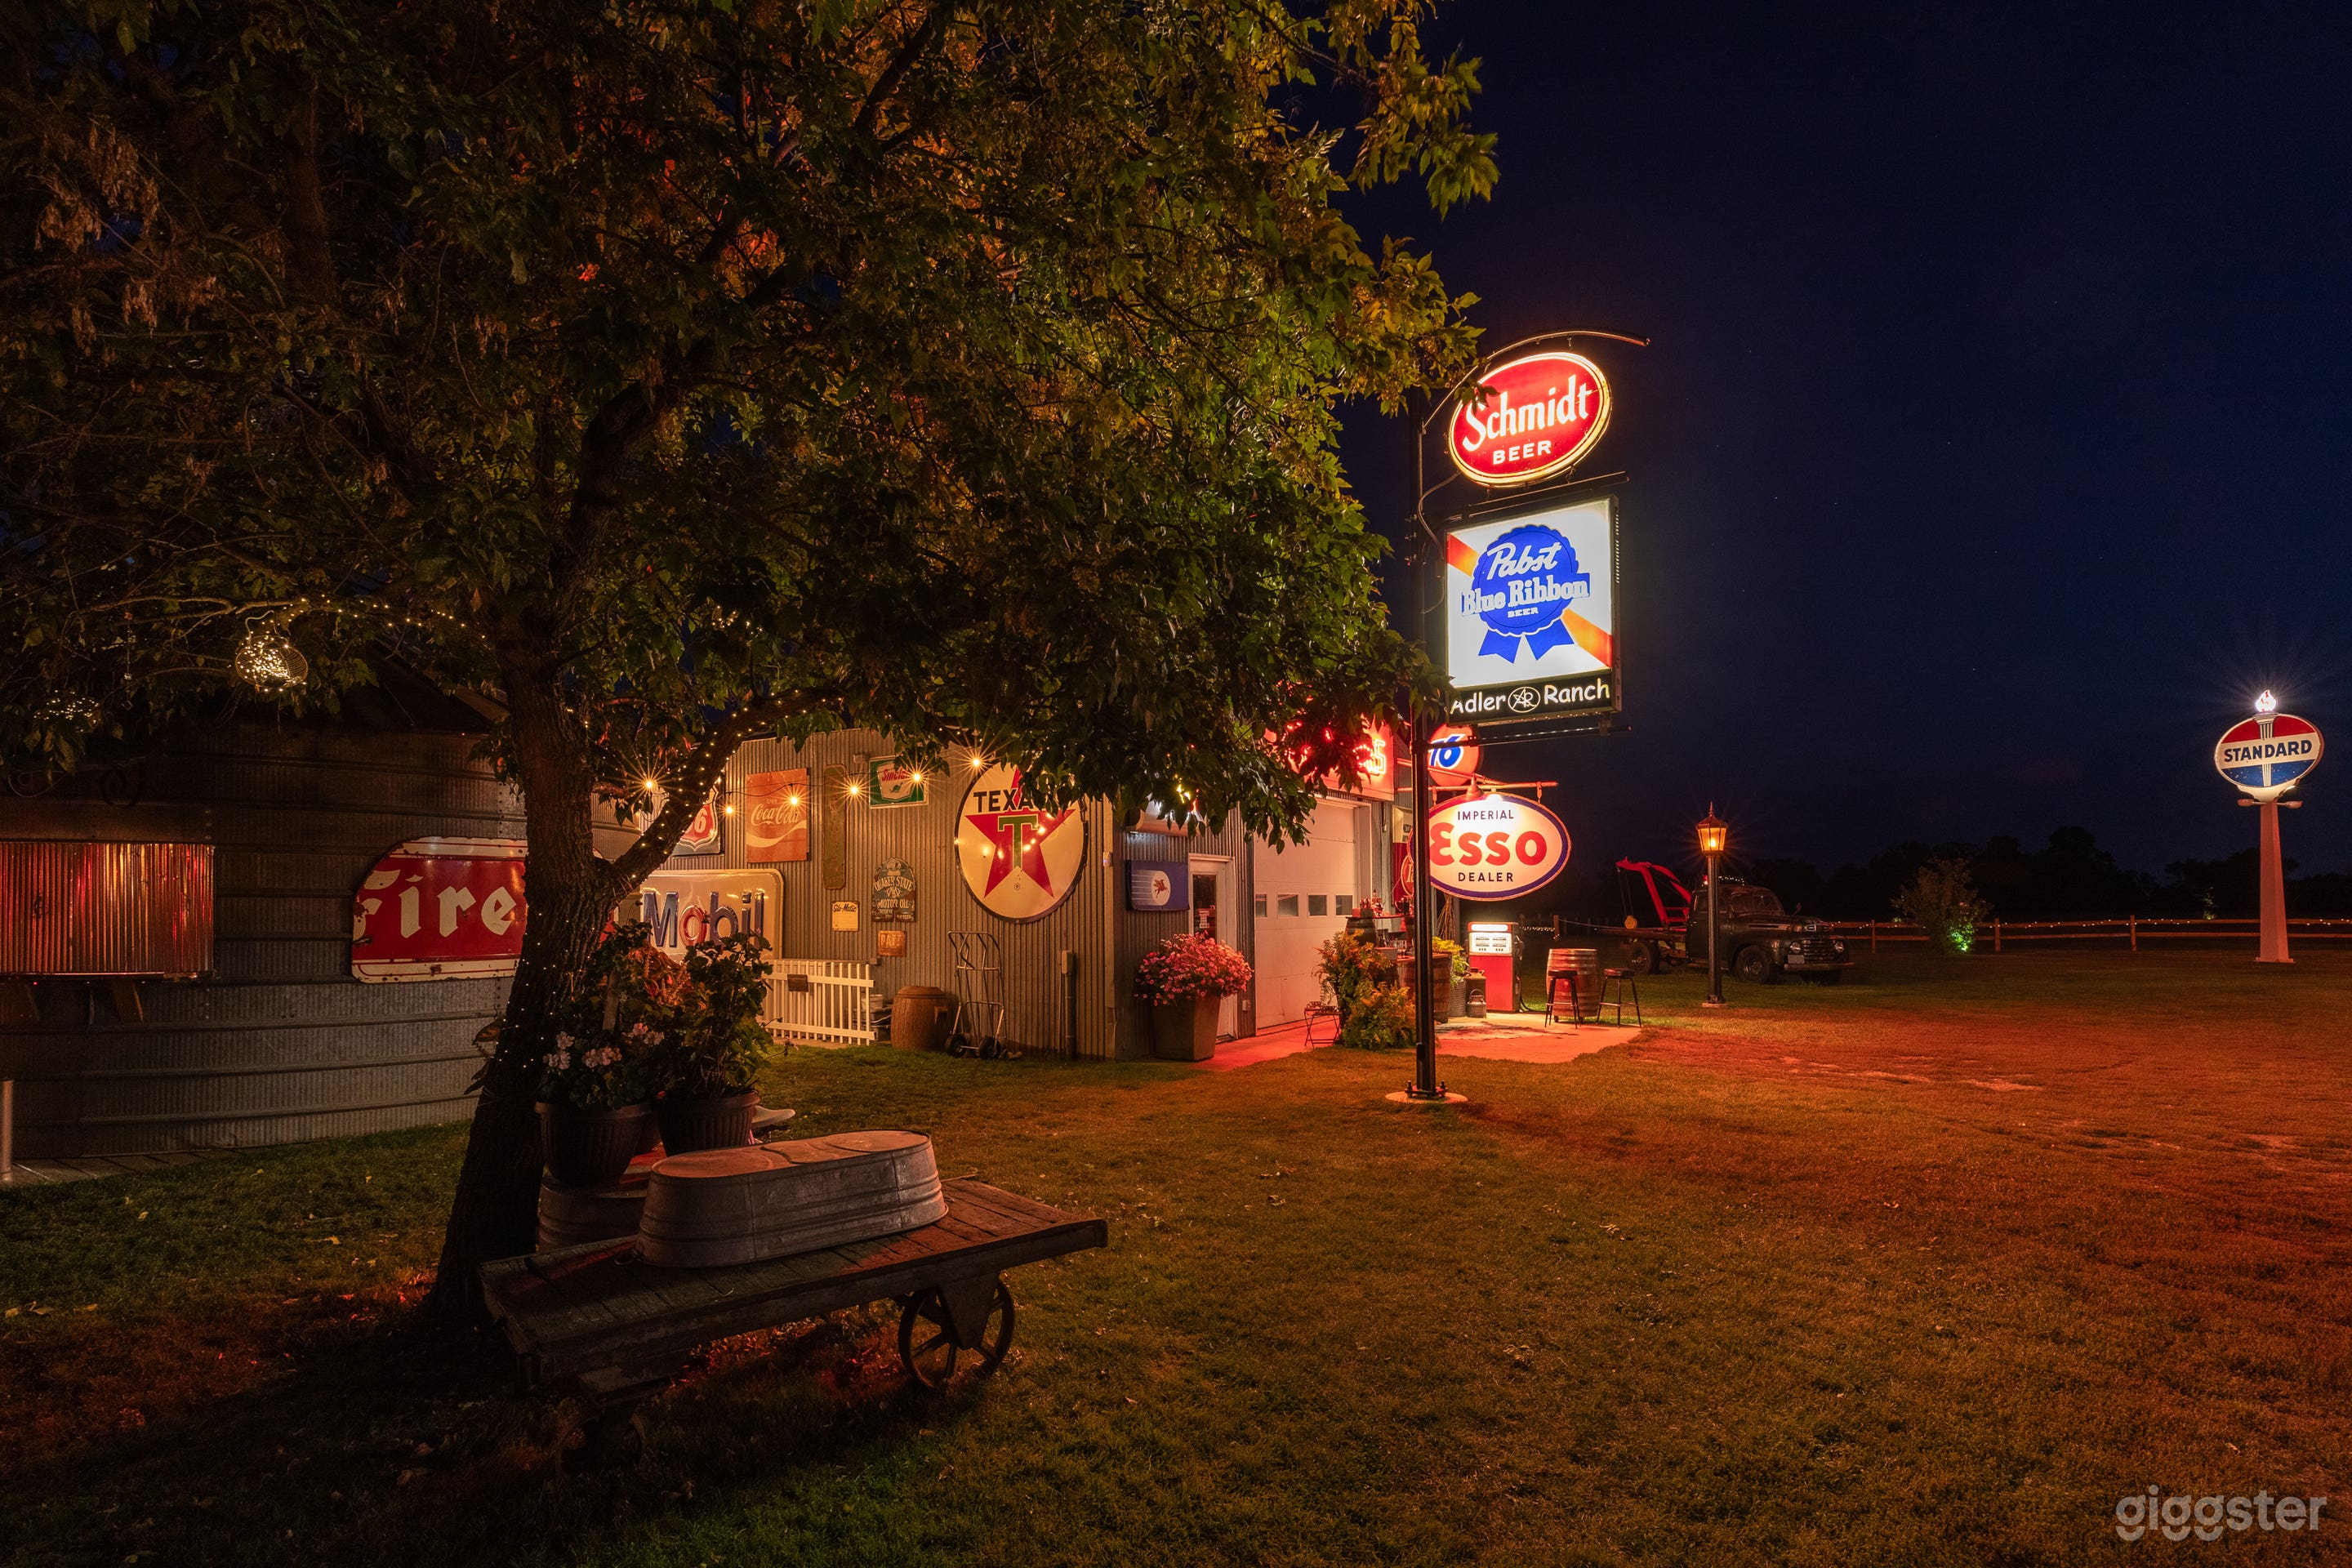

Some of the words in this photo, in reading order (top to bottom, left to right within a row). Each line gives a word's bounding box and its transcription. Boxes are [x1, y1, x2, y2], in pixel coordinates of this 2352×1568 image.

[1463, 374, 1592, 452] Schmidt
[1493, 440, 1552, 465] BEER
[1486, 541, 1562, 580] Pabst
[1462, 588, 1506, 617] Blue
[1508, 575, 1589, 608] Ribbon
[1508, 608, 1539, 618] BEER
[1450, 691, 1506, 715] Adler
[1544, 678, 1610, 705] Ranch
[1428, 733, 1467, 769] 76
[2224, 740, 2313, 762] STANDARD
[1458, 809, 1514, 820] IMPERIAL
[874, 875, 895, 891] QUAKER
[896, 875, 914, 891] STATE
[1459, 872, 1514, 882] DEALER
[877, 898, 898, 908] MOTOR
[899, 898, 910, 908] OIL
[642, 889, 764, 949] Mobil
